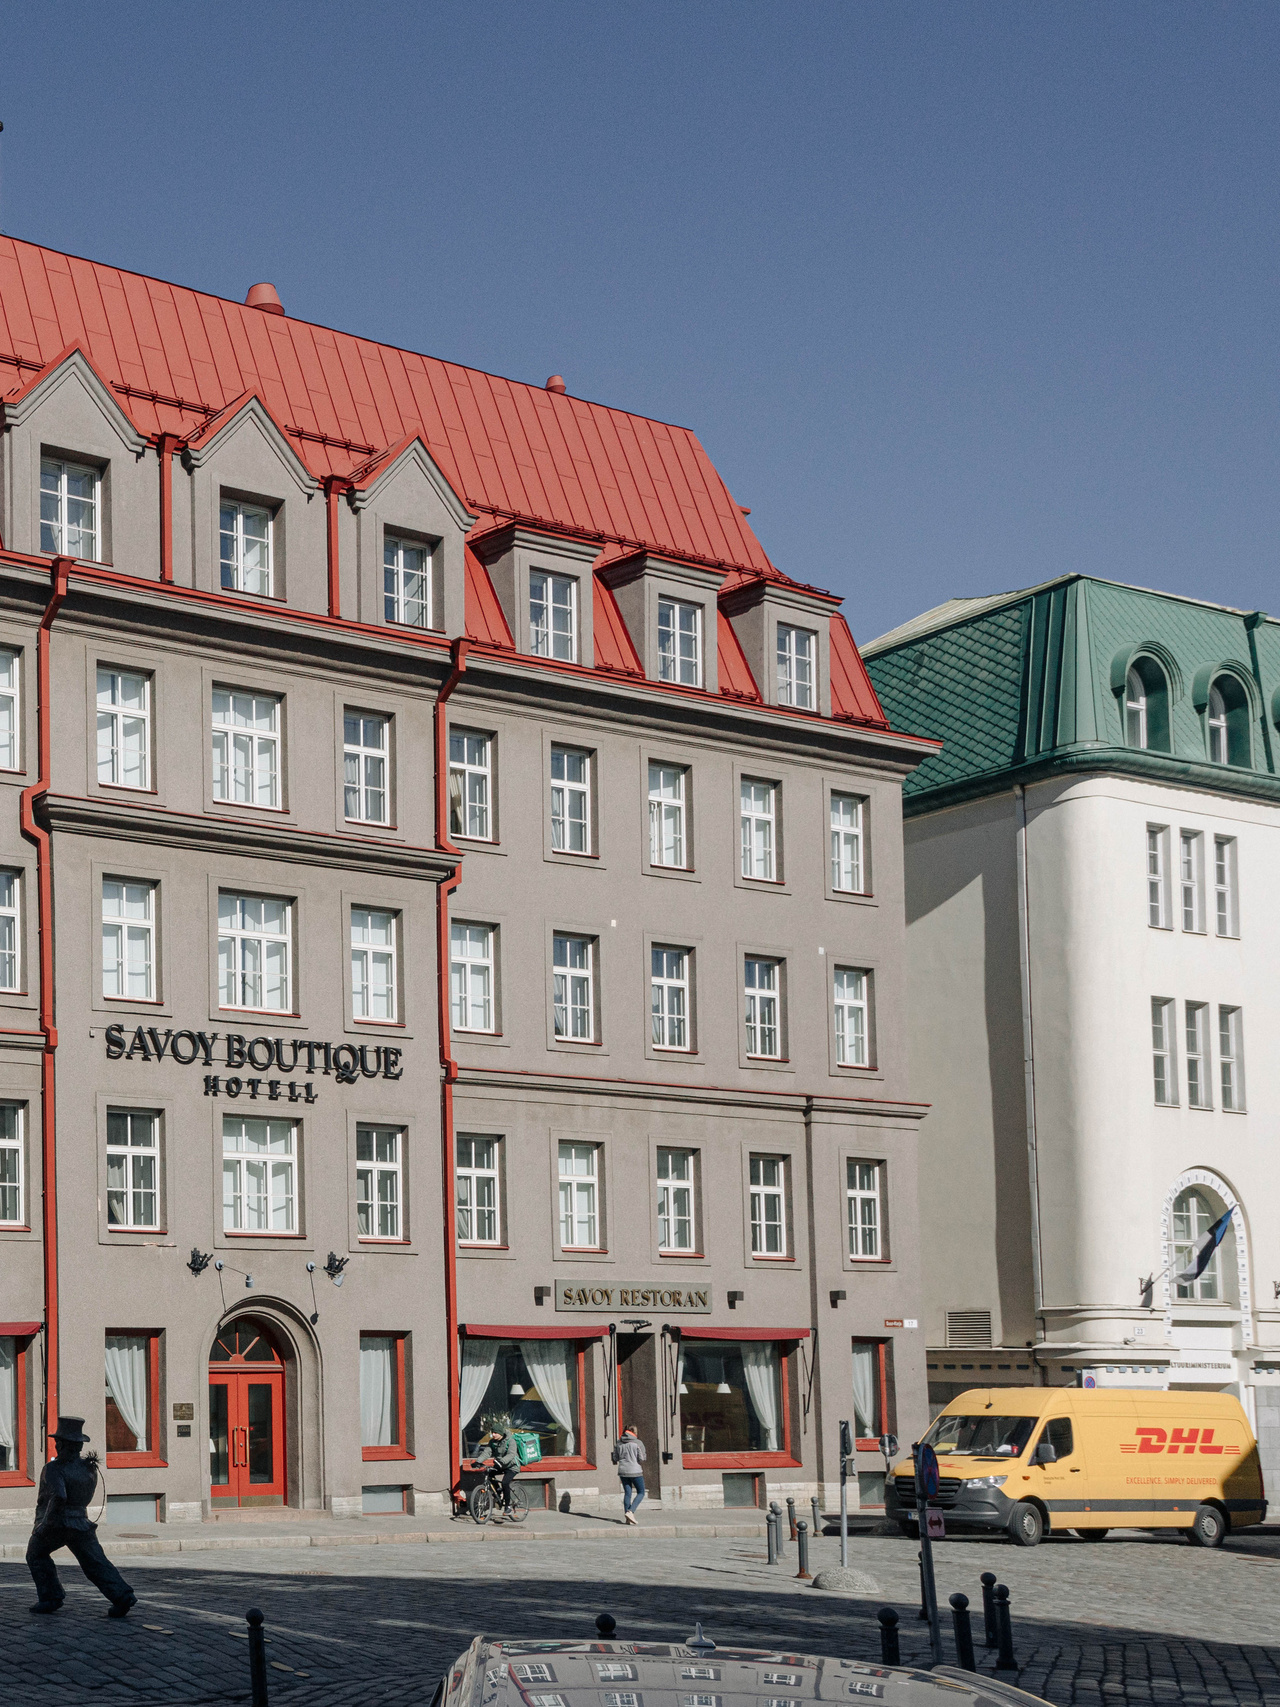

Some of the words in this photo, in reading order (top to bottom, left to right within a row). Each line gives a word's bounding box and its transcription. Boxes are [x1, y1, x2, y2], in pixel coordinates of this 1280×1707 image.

[105, 1023, 219, 1066] SAVOY
[225, 1033, 404, 1085] BOUTIQUE
[203, 1074, 319, 1104] HOTELL
[563, 1287, 615, 1306] SAVOY
[619, 1288, 709, 1308] RESTORAN
[1170, 1361, 1232, 1369] LTUURIMINISTEERIUM
[1135, 1427, 1224, 1455] DHL
[1164, 1477, 1185, 1485] SIMPLY
